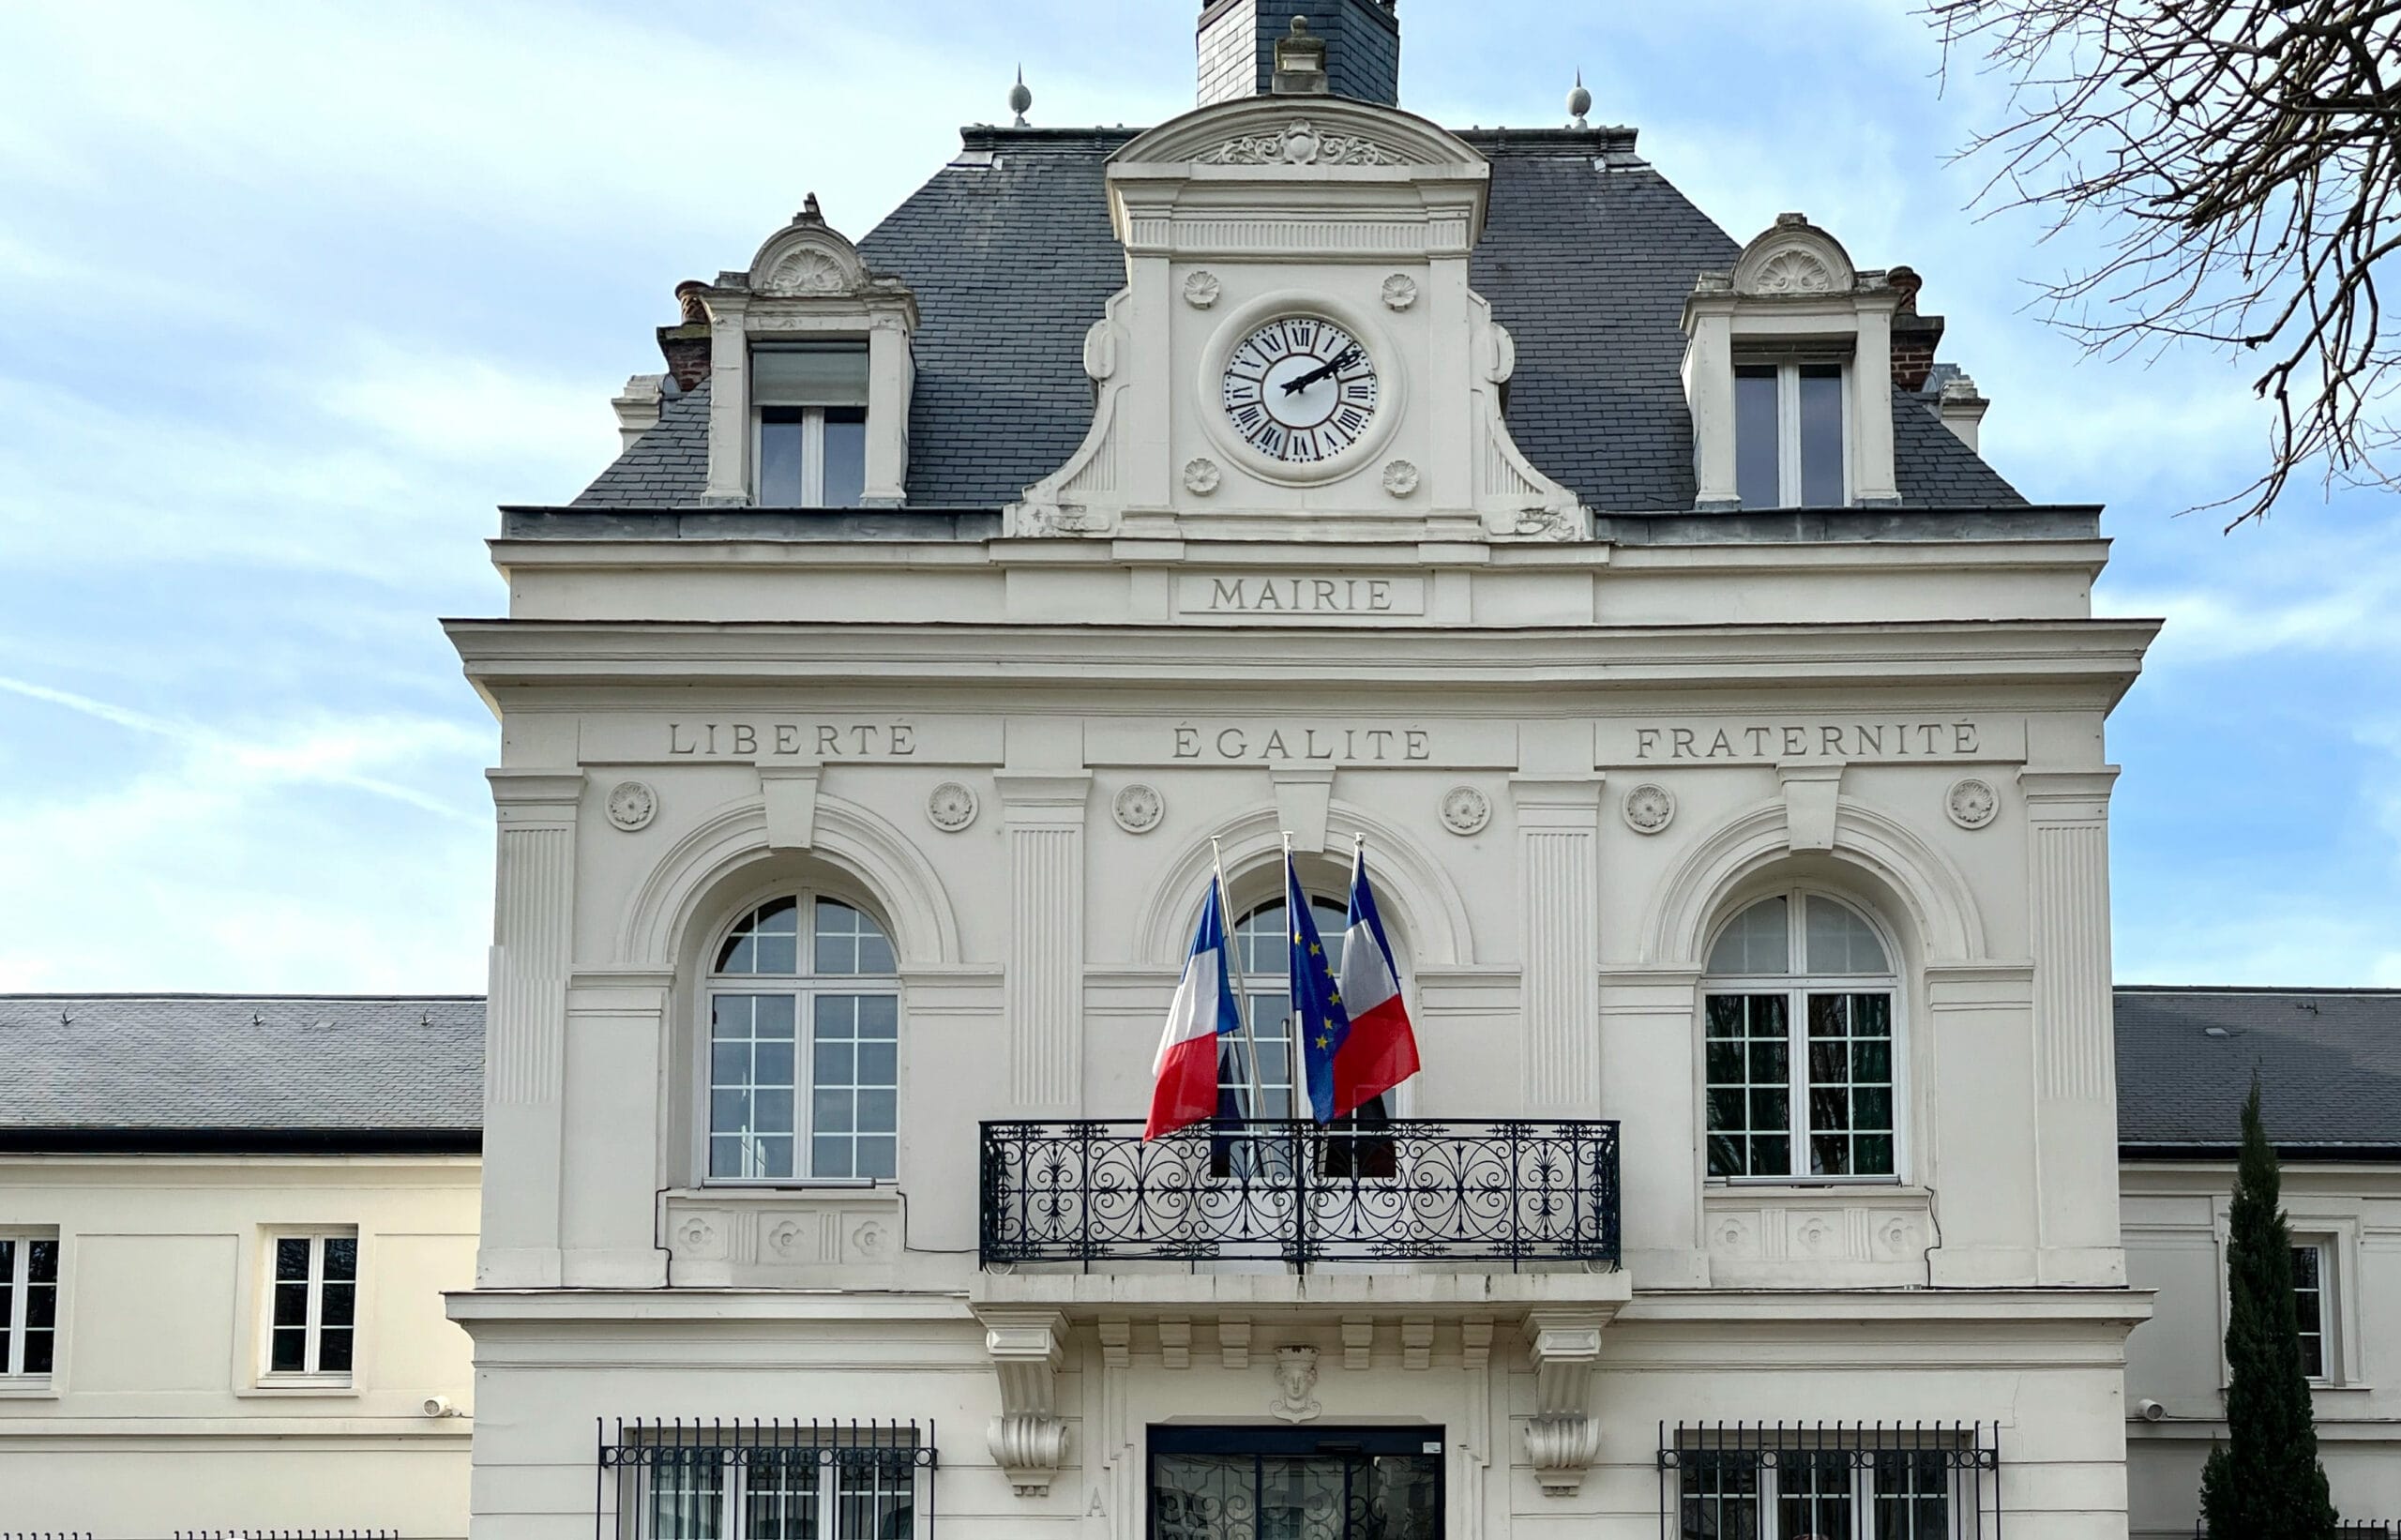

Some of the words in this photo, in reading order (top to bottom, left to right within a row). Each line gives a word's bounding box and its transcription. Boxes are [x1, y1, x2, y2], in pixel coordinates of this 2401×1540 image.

[1261, 333, 1281, 353] XI
[1291, 327, 1310, 347] XII
[1322, 336, 1336, 353] I
[1240, 356, 1261, 371] X
[1232, 385, 1253, 399] IX
[1348, 385, 1368, 400] III
[1238, 406, 1262, 431] VIII
[1337, 408, 1363, 431] IIII
[1260, 427, 1282, 451] VII
[1293, 436, 1309, 456] VI
[1323, 430, 1337, 450] V
[1209, 578, 1393, 611] MAIRIE
[669, 717, 916, 755] LIBERTÉ
[1171, 721, 1430, 761] ÉGALITÉ
[1636, 717, 1980, 758] FRATERNITÉ
[1085, 1486, 1107, 1517] A
